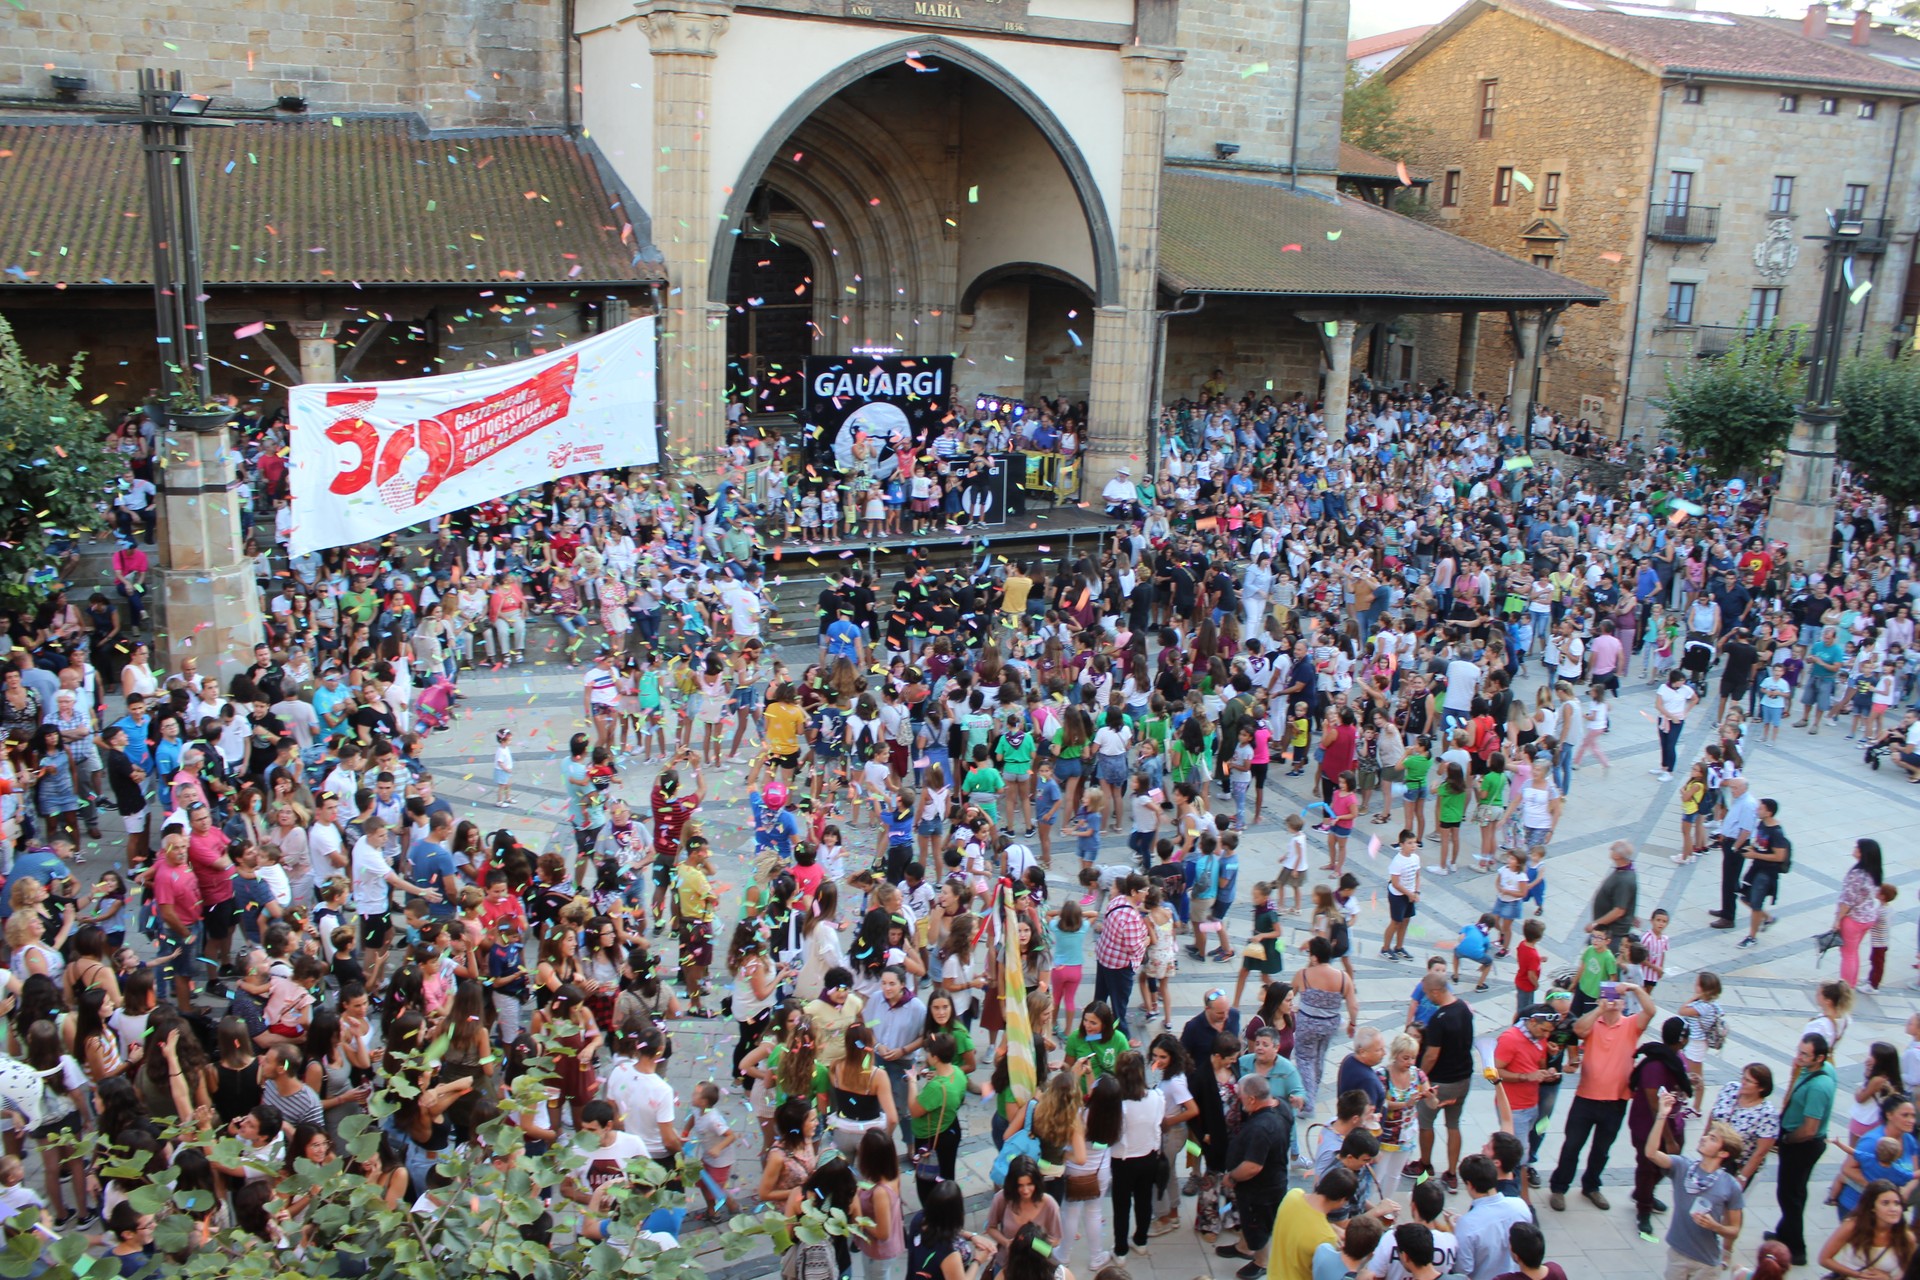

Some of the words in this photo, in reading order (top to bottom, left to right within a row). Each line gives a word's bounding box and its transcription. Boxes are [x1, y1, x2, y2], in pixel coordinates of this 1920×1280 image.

[914, 1, 963, 19] MARÍA
[814, 368, 943, 397] GAUARGI
[463, 398, 542, 447] AUTOGESTIOA
